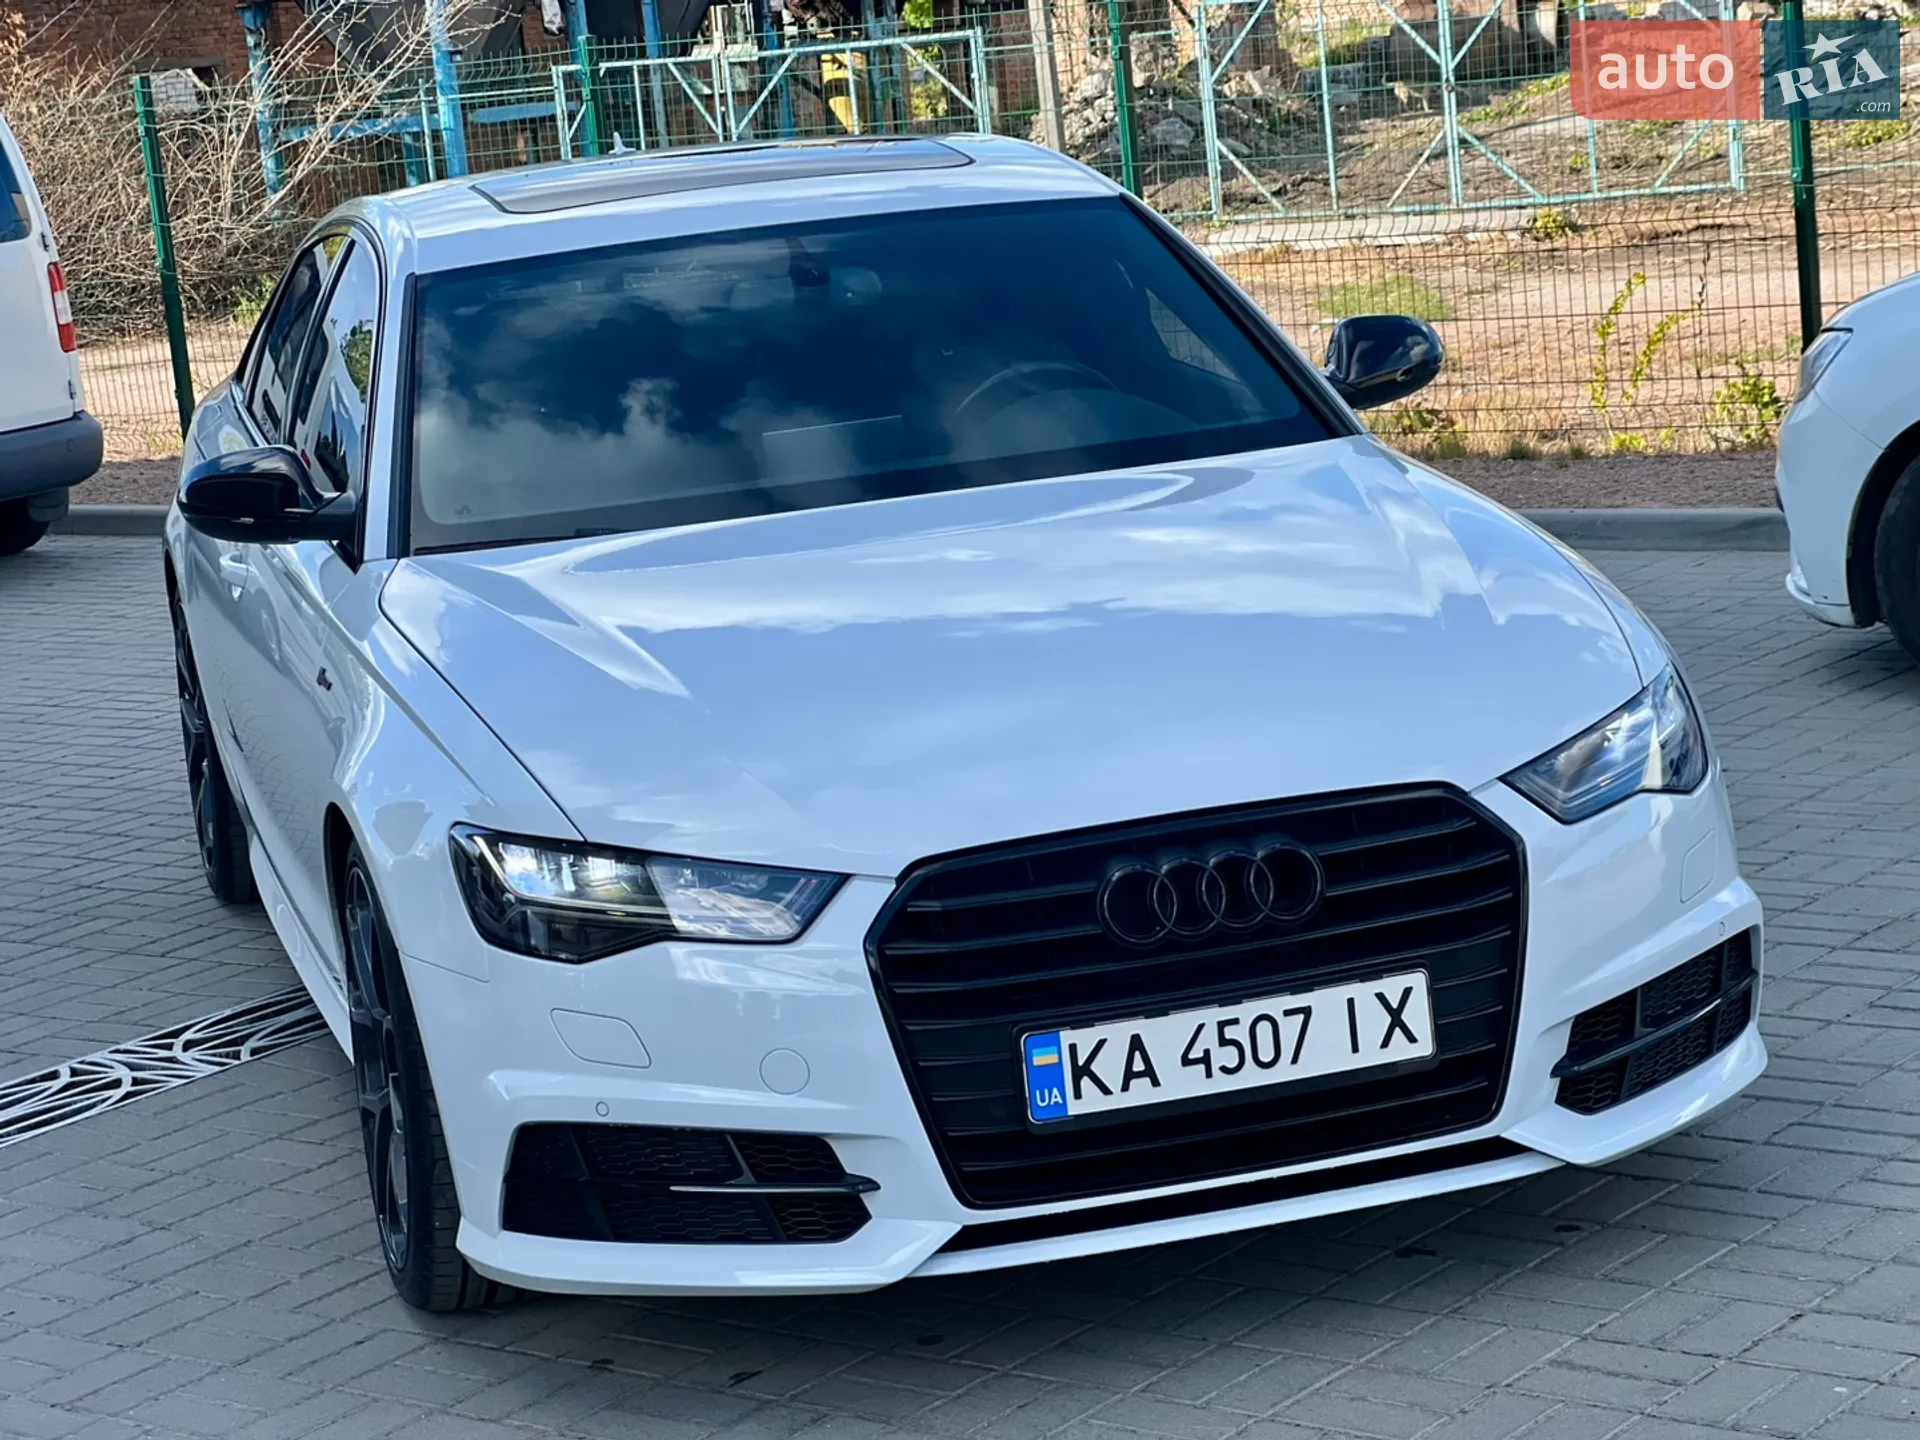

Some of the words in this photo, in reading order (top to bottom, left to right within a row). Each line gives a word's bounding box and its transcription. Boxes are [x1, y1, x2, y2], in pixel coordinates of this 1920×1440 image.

[1068, 1033, 1161, 1100] KA
[1180, 1005, 1312, 1079] 4507
[1036, 1091, 1063, 1107] UA
